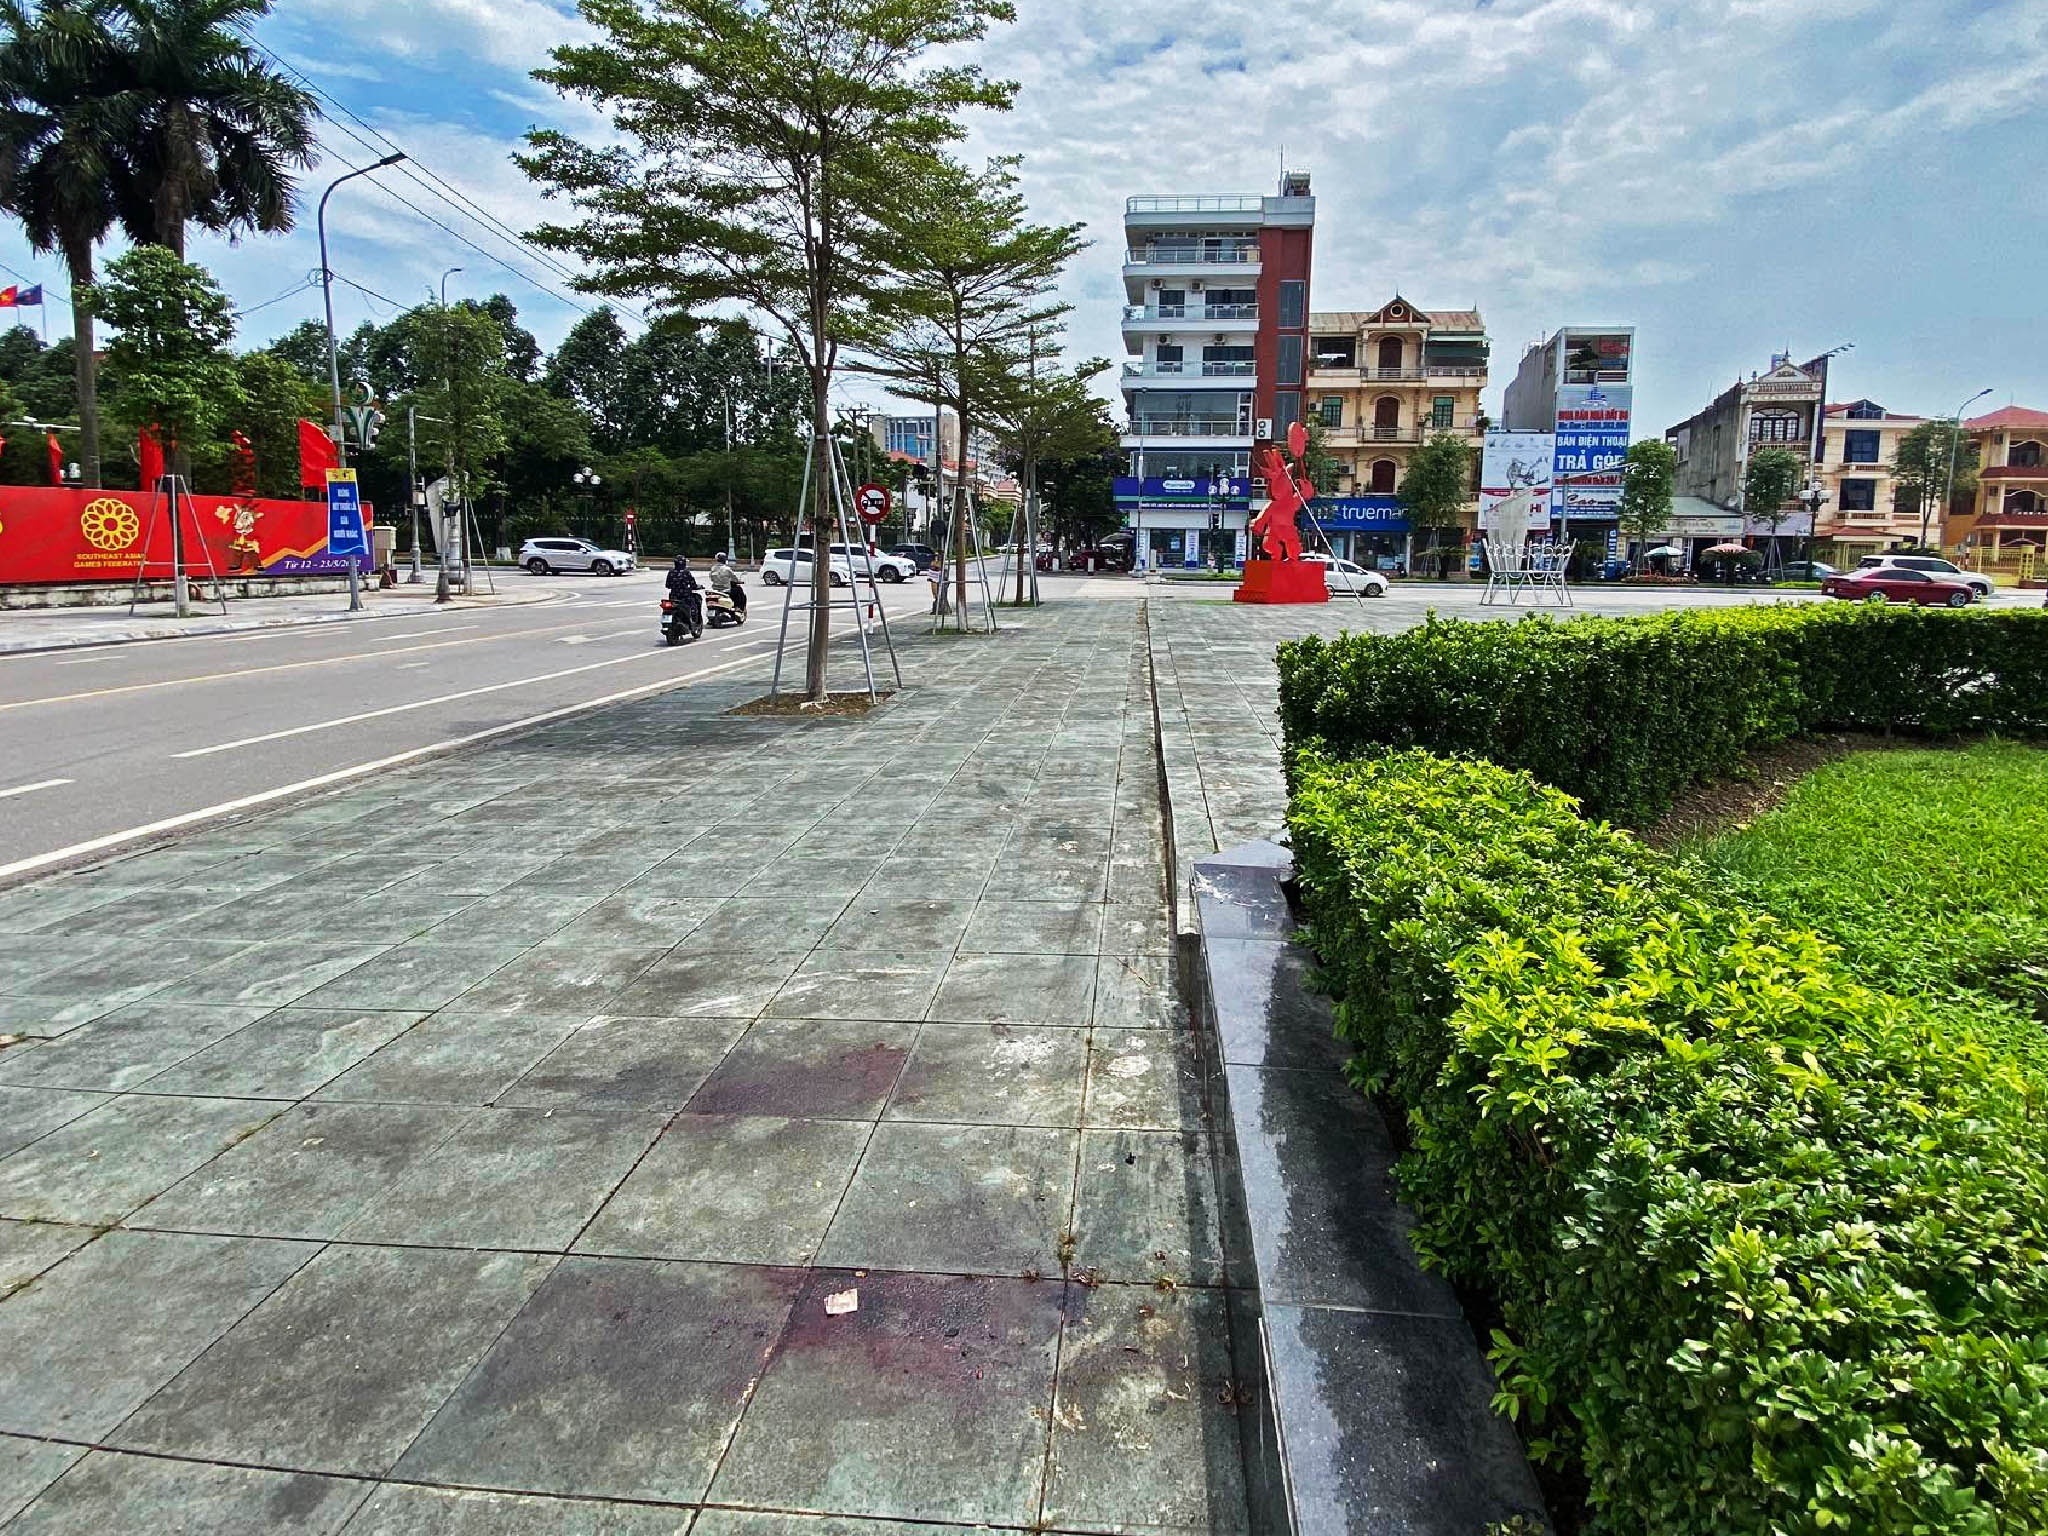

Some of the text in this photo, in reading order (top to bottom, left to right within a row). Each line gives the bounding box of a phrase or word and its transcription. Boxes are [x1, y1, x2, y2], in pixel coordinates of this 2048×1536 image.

[1557, 433, 1627, 449] BÁN ĐIỆN THOẠI
[1557, 450, 1587, 470] TRẢ
[1343, 505, 1408, 520] truemar
[319, 559, 361, 568] 23/5/202
